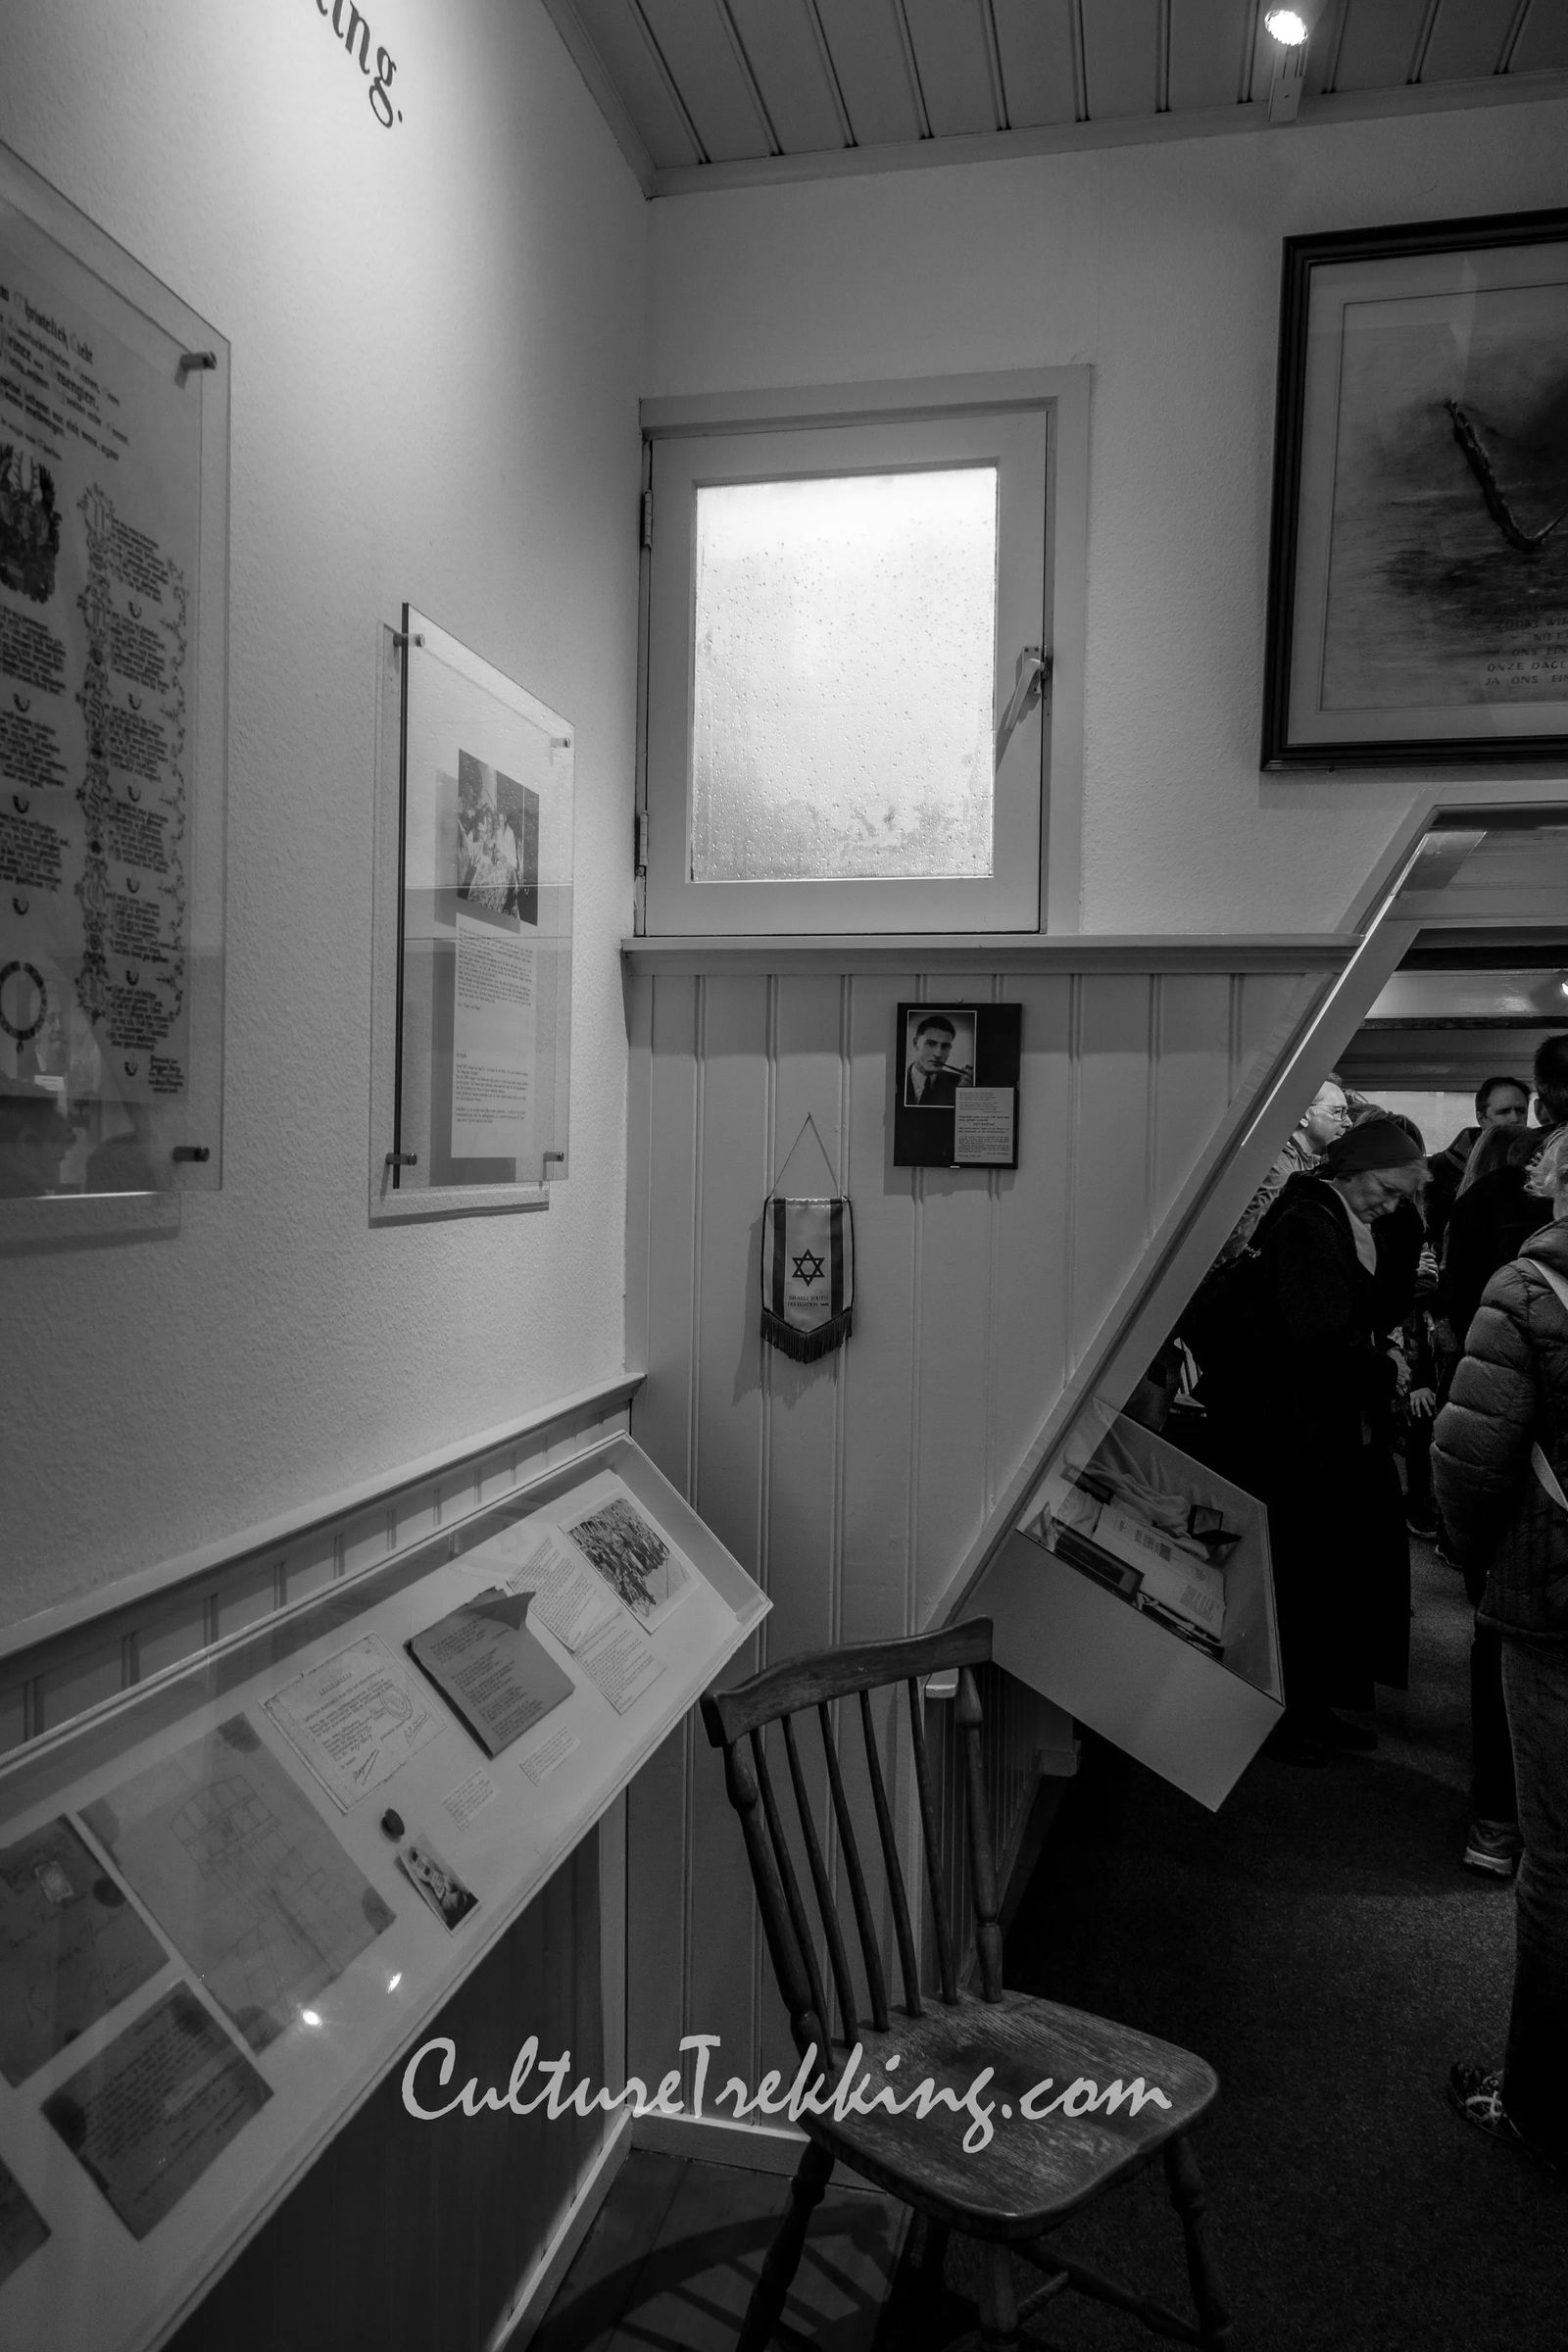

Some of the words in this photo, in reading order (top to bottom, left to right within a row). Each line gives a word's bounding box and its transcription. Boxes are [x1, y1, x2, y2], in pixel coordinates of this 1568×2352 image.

[317, 0, 403, 128] ing.
[1487, 662, 1526, 672] ONZE
[1511, 675, 1538, 684] ONS
